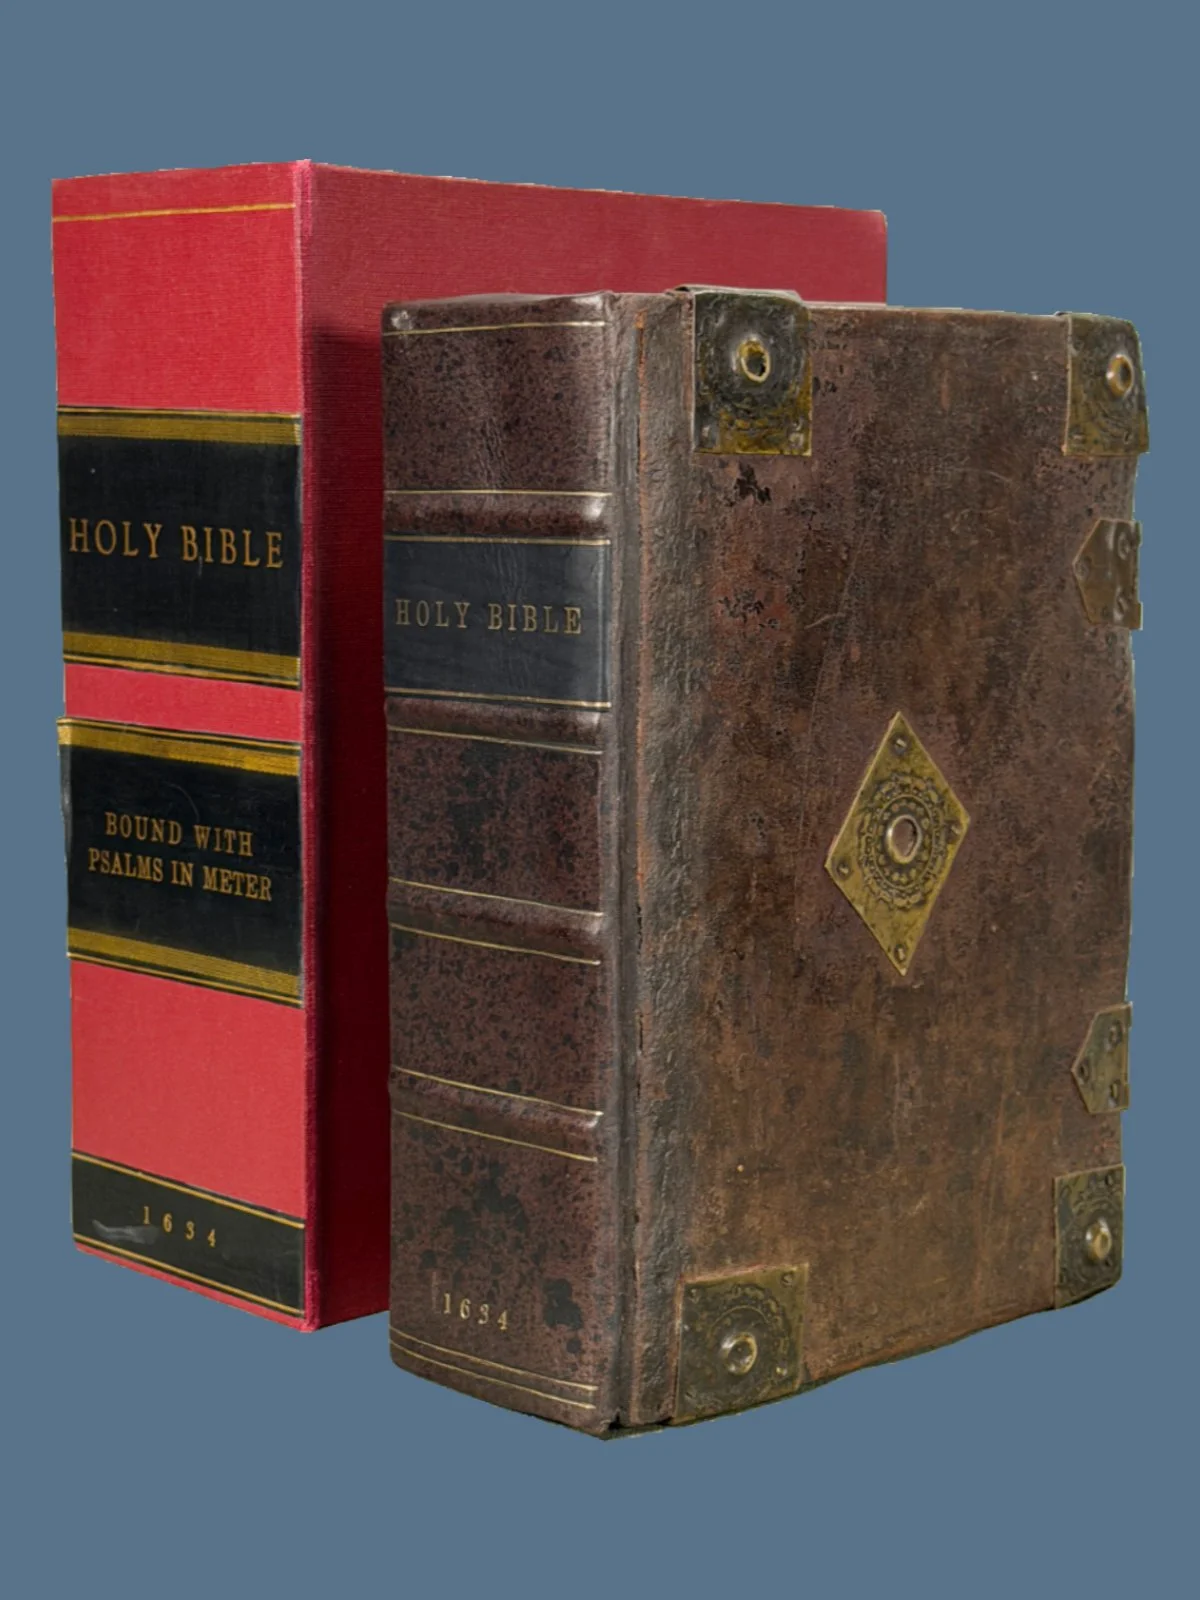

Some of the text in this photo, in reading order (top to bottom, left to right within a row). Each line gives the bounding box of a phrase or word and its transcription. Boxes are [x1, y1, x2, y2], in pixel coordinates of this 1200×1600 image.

[69, 517, 284, 568] HOLY BIBLE
[395, 598, 582, 634] HOLY BIBLE
[105, 811, 254, 857] BOUND WITH
[88, 847, 272, 901] PSALMS IN METER
